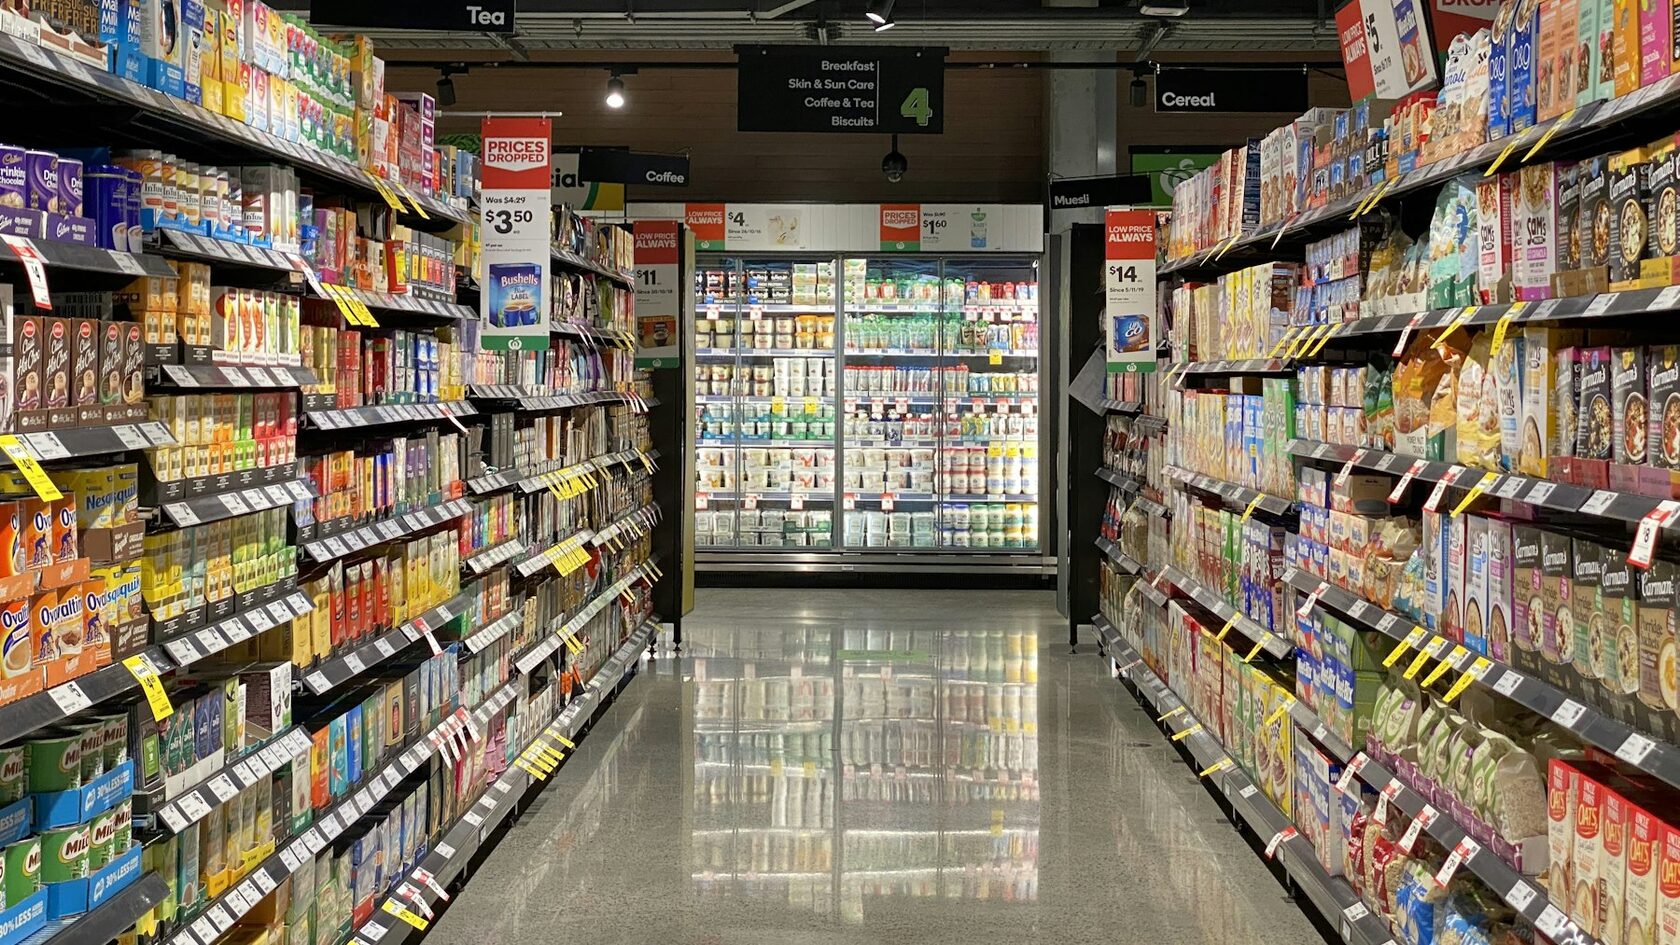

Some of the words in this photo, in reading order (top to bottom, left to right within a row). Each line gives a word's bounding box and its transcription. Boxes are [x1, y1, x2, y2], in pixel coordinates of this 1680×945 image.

[466, 5, 505, 26] Tea
[821, 60, 875, 71] Breakfast
[788, 78, 812, 90] Skin
[813, 79, 823, 90] &
[824, 79, 846, 90] Sun
[847, 80, 875, 90] Care
[804, 97, 841, 108] Coffee
[842, 98, 852, 109] &
[852, 98, 875, 108] Tea
[1161, 91, 1216, 107] Cereal
[900, 87, 933, 127] 4
[831, 116, 875, 127] Biscuits
[487, 140, 545, 153] PRICES
[487, 153, 545, 163] DROPPED
[645, 170, 685, 184] Coffee
[485, 196, 503, 204] Was
[1054, 194, 1090, 206] Muesli
[687, 216, 724, 225] ALWAYS
[728, 211, 746, 227] $4
[884, 212, 917, 220] PRICES
[1128, 225, 1153, 233] PRICE
[635, 232, 653, 240] LOW
[654, 232, 676, 240] PRICE
[1108, 233, 1154, 242] ALWAYS
[635, 239, 677, 249] ALWAYS
[501, 271, 539, 288] Bushells
[636, 269, 657, 286] $11
[1109, 265, 1138, 283] $14
[510, 293, 529, 301] LABEL
[1550, 788, 1566, 810] OATS
[1578, 803, 1598, 829] OATS
[1604, 820, 1622, 846] OATS
[1630, 837, 1650, 864] OATS
